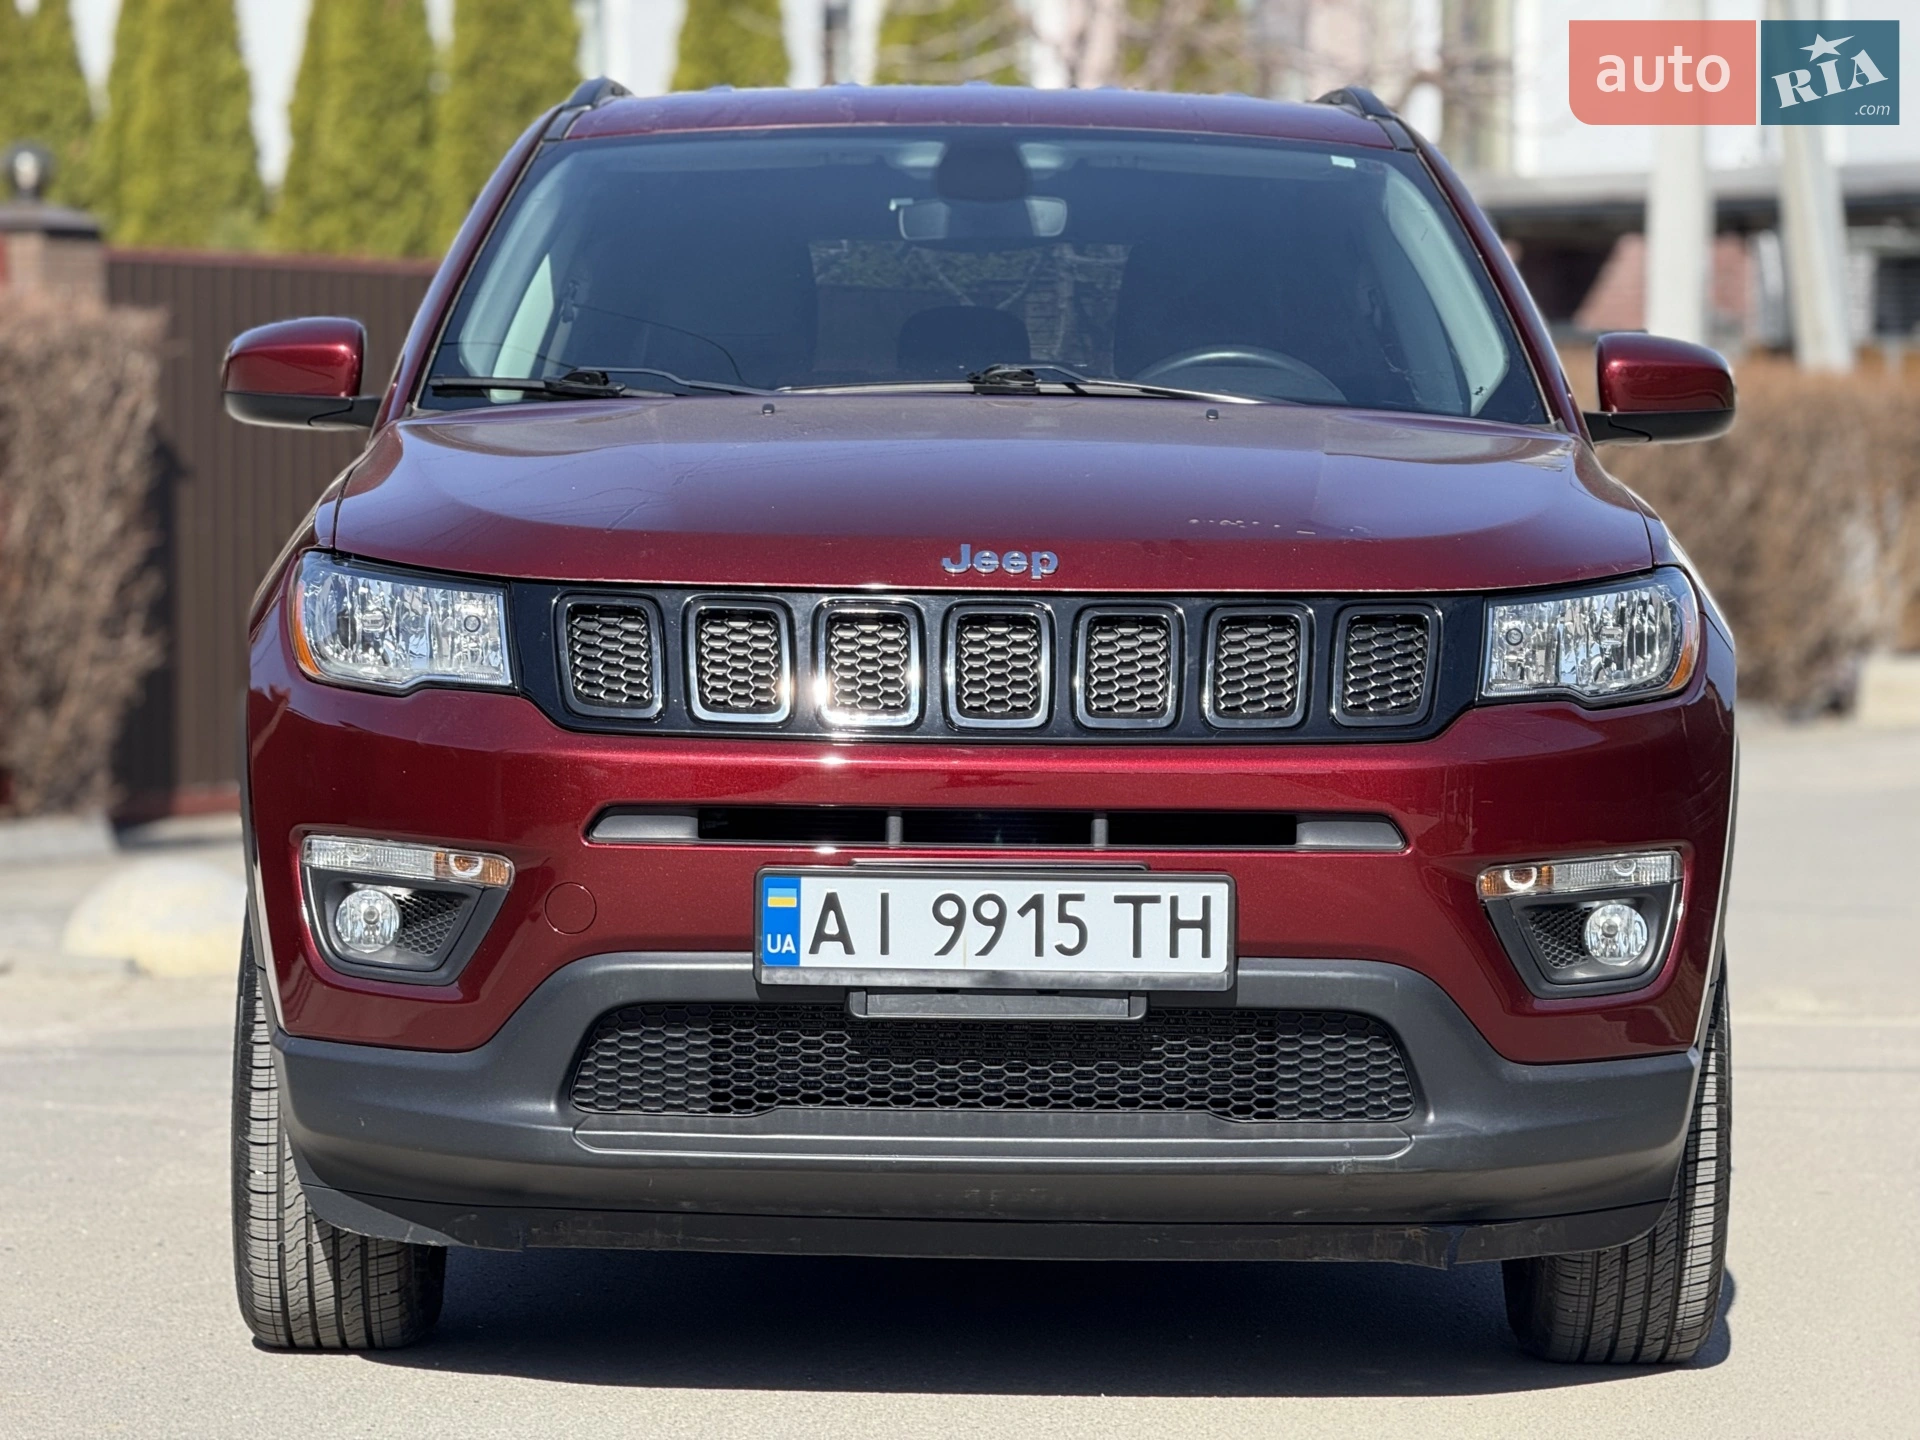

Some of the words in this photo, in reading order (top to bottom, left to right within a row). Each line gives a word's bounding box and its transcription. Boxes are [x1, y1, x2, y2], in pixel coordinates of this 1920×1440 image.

[941, 543, 1059, 580] Jeep
[766, 933, 796, 954] UA
[808, 891, 890, 956] AI
[931, 892, 1089, 958] 9915
[1113, 894, 1212, 959] TH
